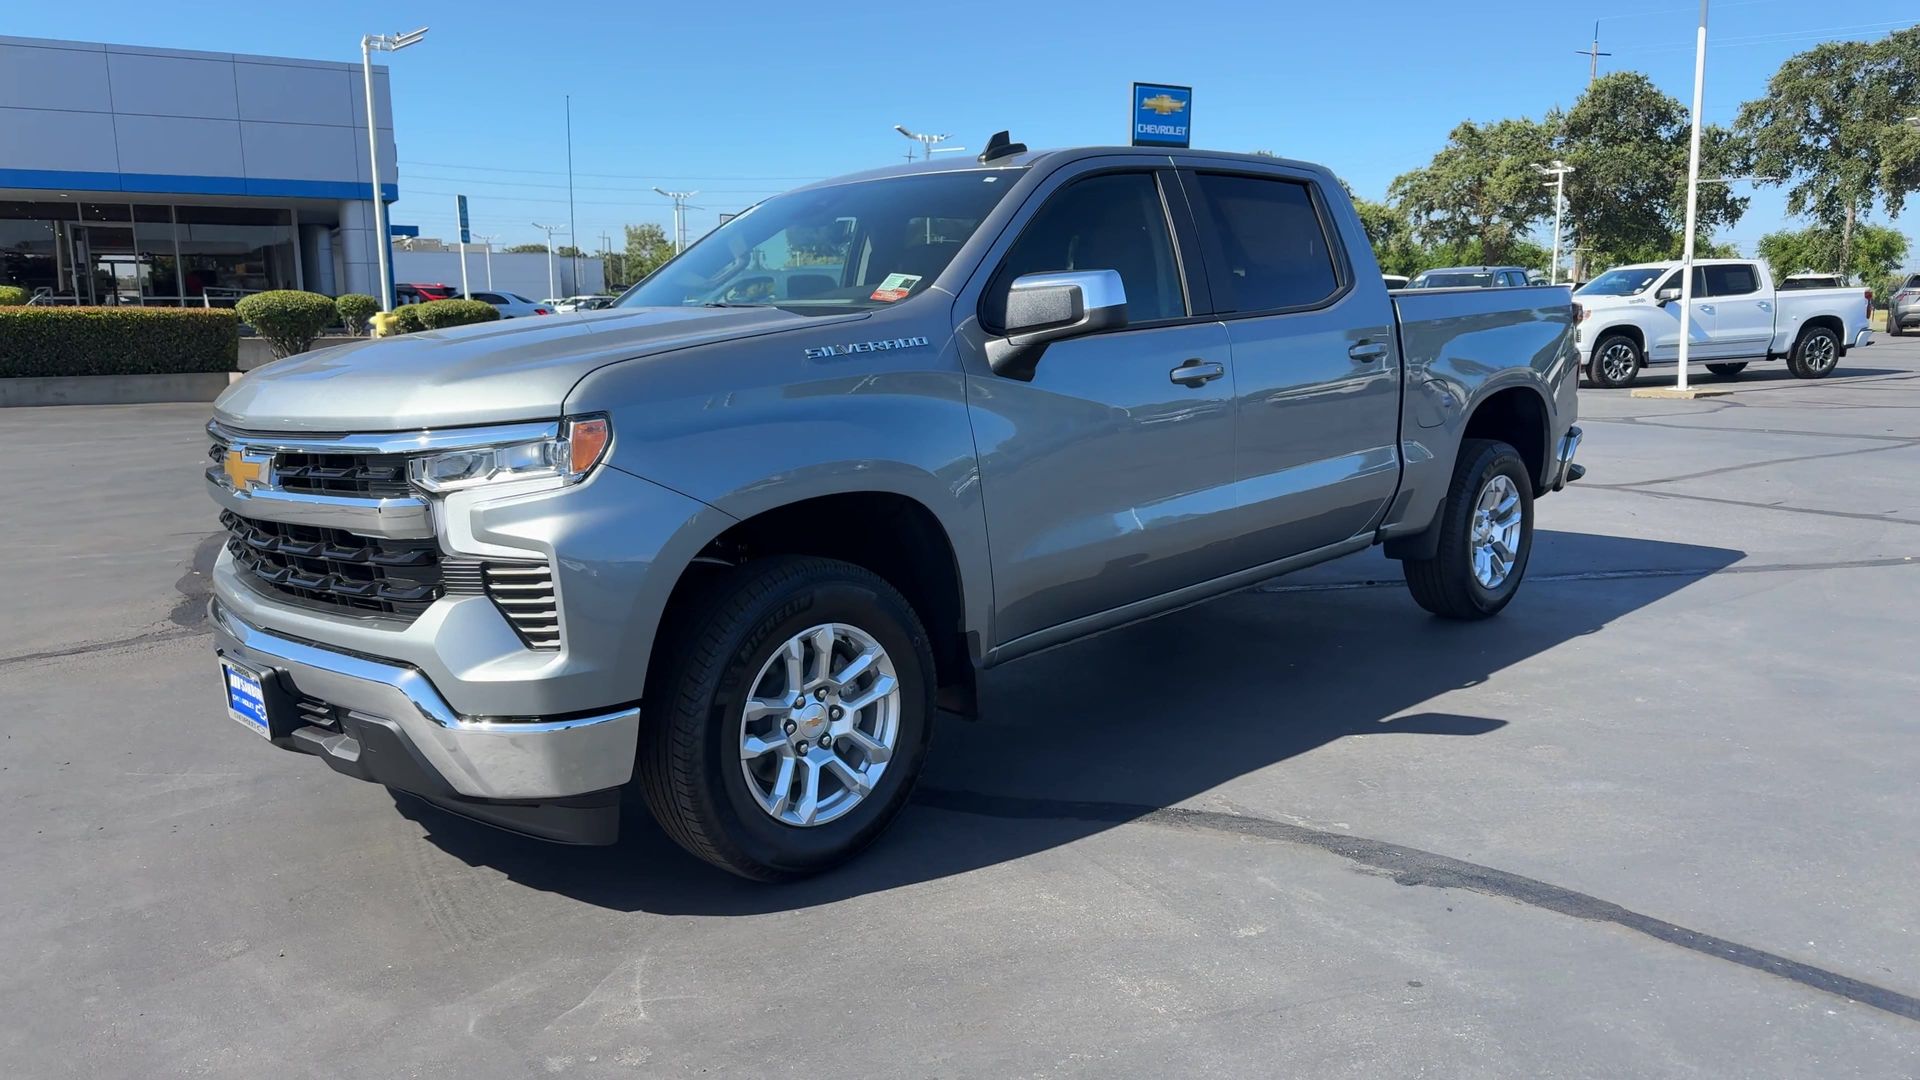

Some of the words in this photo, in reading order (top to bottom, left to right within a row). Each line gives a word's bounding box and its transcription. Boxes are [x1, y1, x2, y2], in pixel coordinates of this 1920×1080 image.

[1137, 124, 1187, 136] CHEVROLET
[805, 336, 929, 359] SILVERADO
[740, 594, 812, 664] MICHELIN
